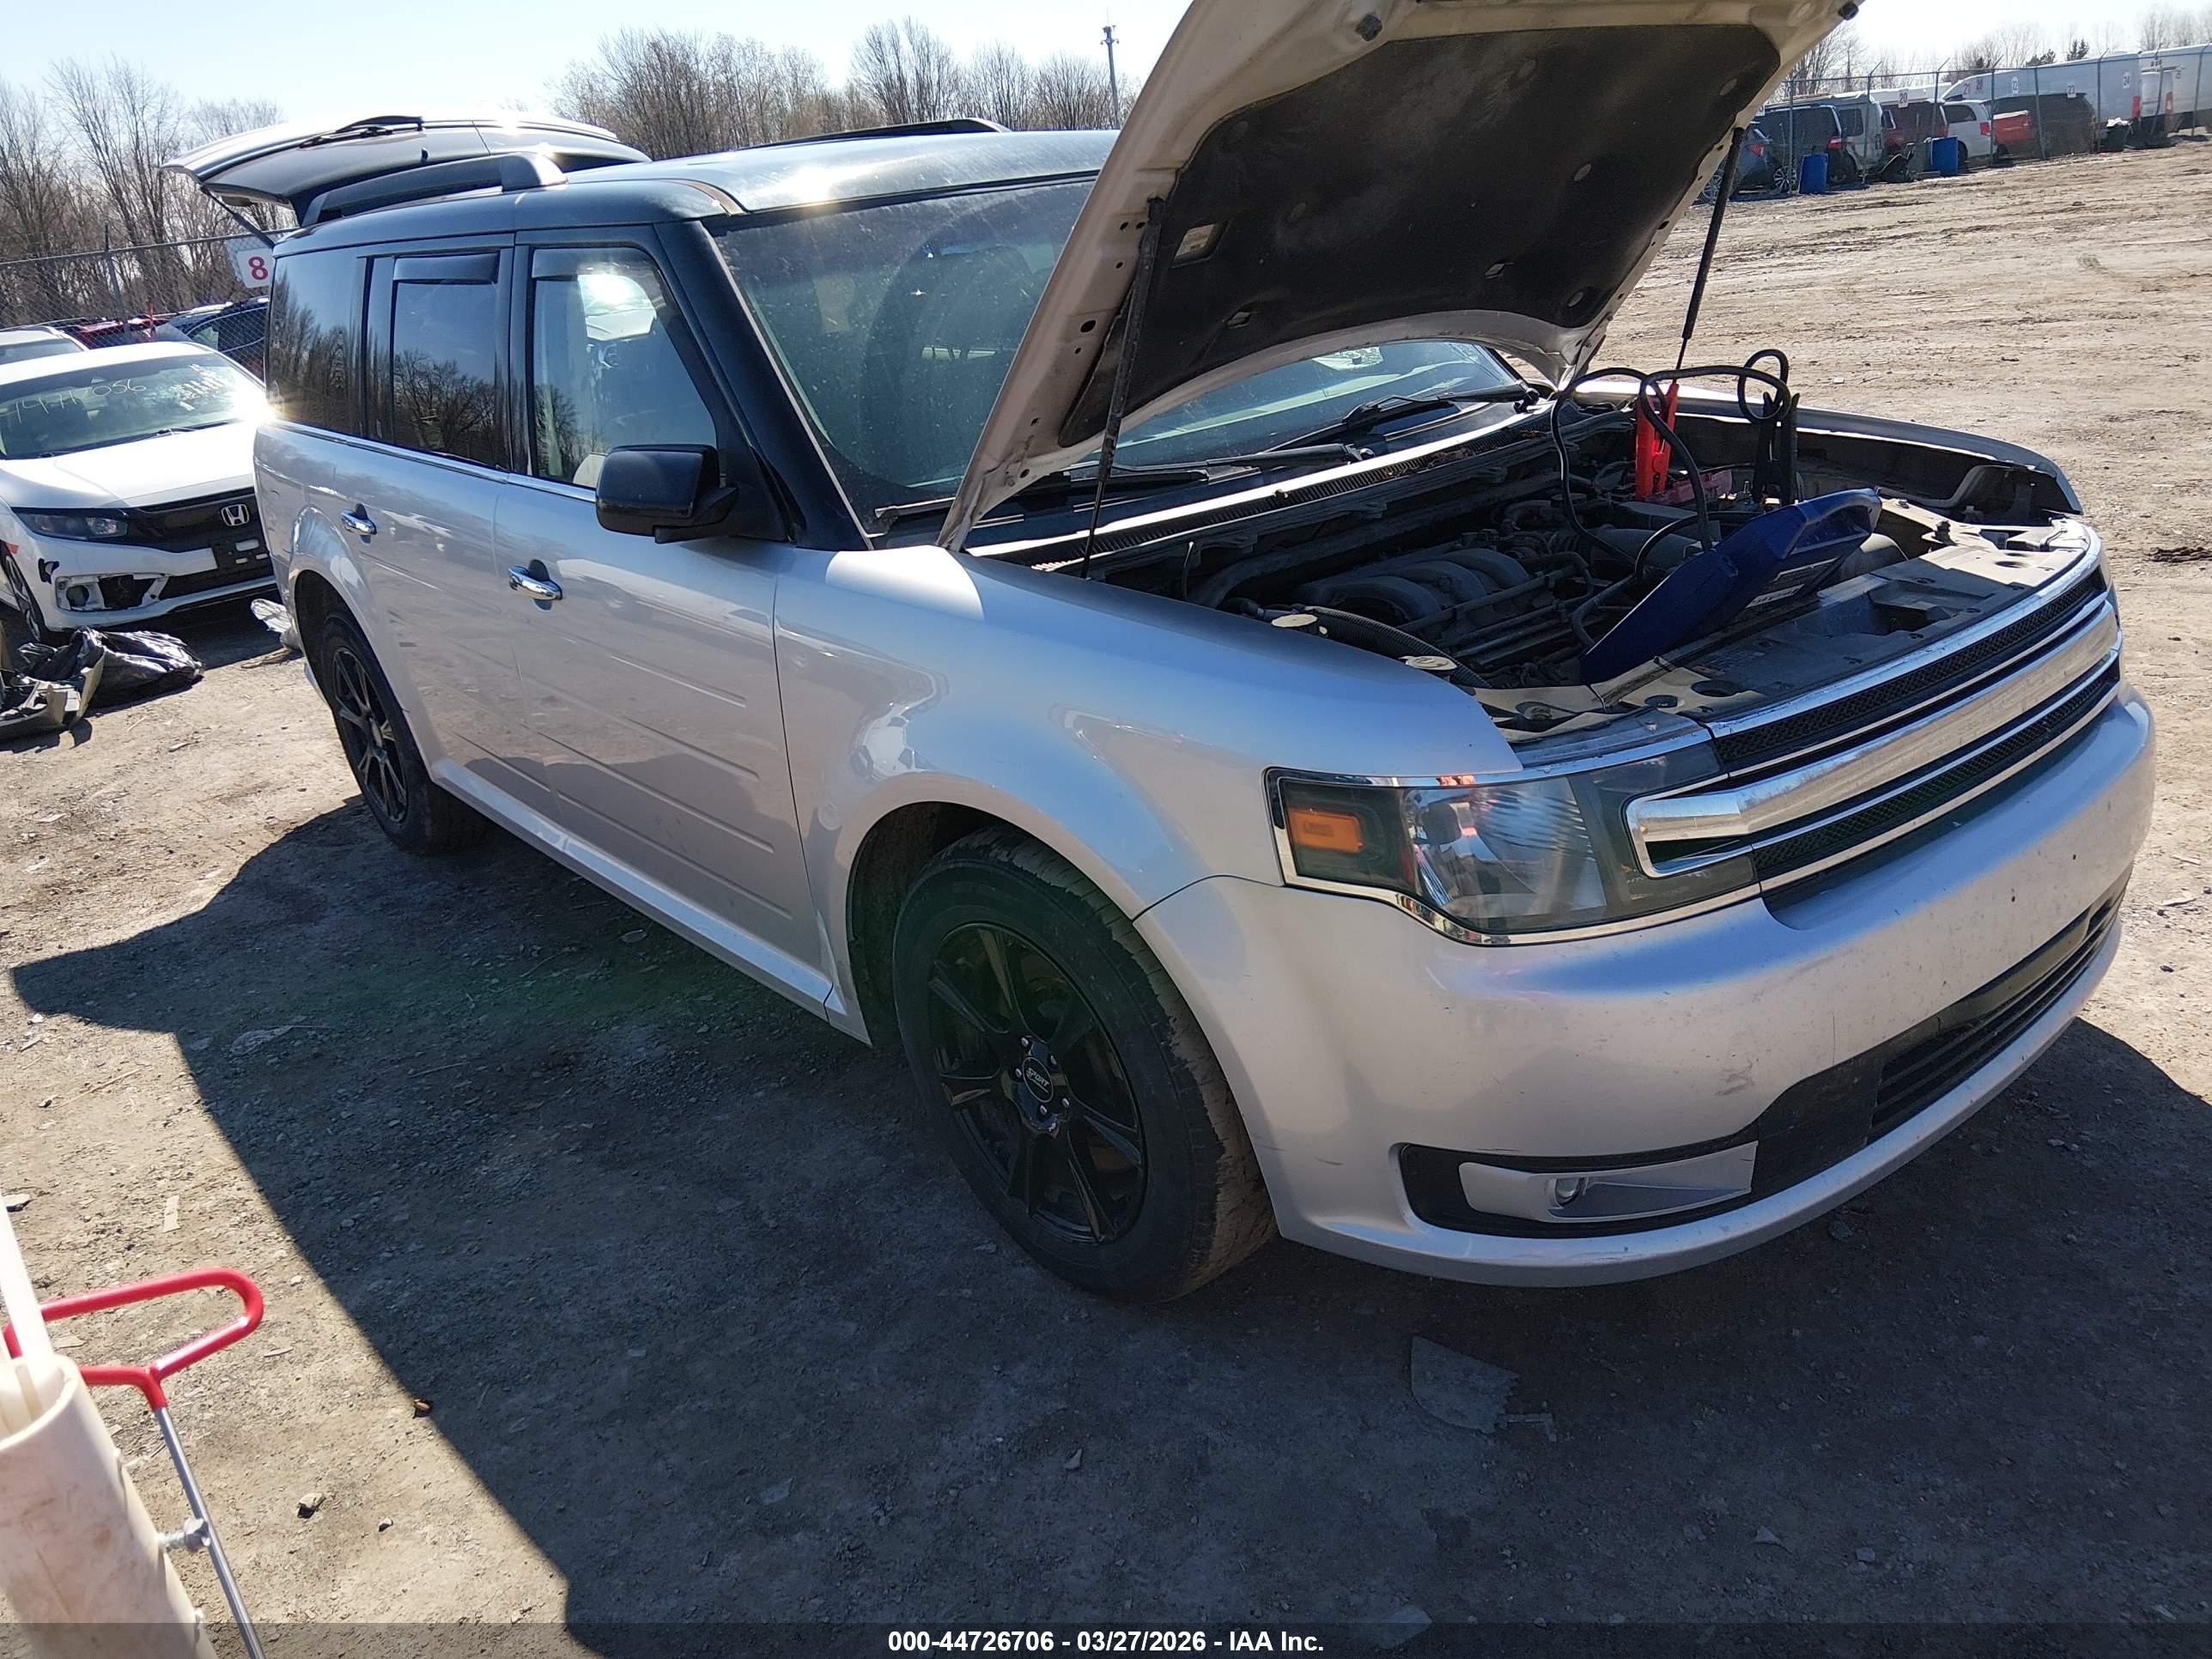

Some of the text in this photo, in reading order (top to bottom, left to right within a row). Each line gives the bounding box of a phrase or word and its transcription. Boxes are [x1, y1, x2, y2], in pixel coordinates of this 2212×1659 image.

[1899, 92, 1908, 104] 20
[248, 256, 268, 280] 8
[1026, 1067, 1049, 1087] SPORT
